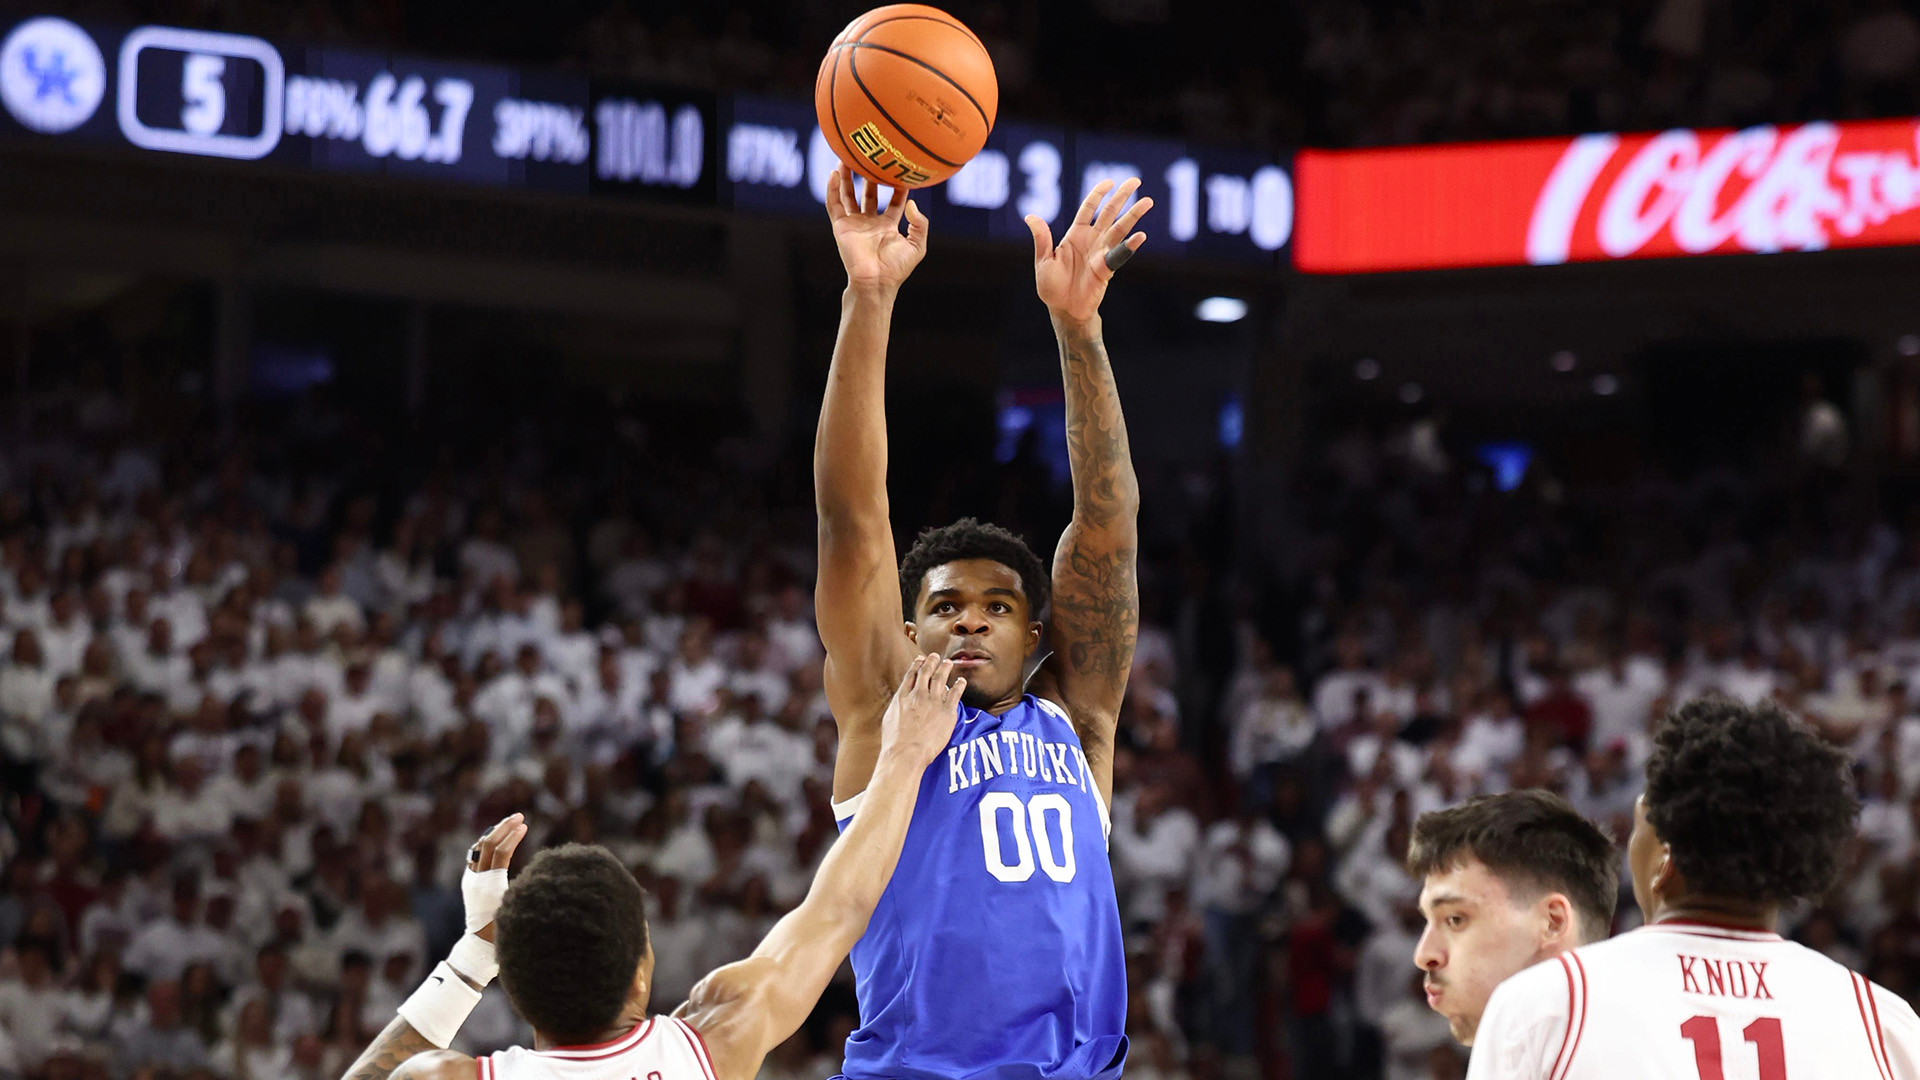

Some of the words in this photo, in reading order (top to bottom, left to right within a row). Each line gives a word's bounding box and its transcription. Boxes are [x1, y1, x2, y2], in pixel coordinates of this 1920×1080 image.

[181, 52, 226, 138] 5
[363, 71, 474, 165] 66.7
[1017, 140, 1062, 224] 3
[1165, 157, 1200, 243] 1
[1248, 164, 1294, 252] 0
[849, 123, 931, 186] ELITE
[948, 730, 1088, 794] KENTUCKY
[978, 791, 1077, 883] 00
[1677, 954, 1775, 1000] KNOX
[1680, 1015, 1787, 1080] 11
